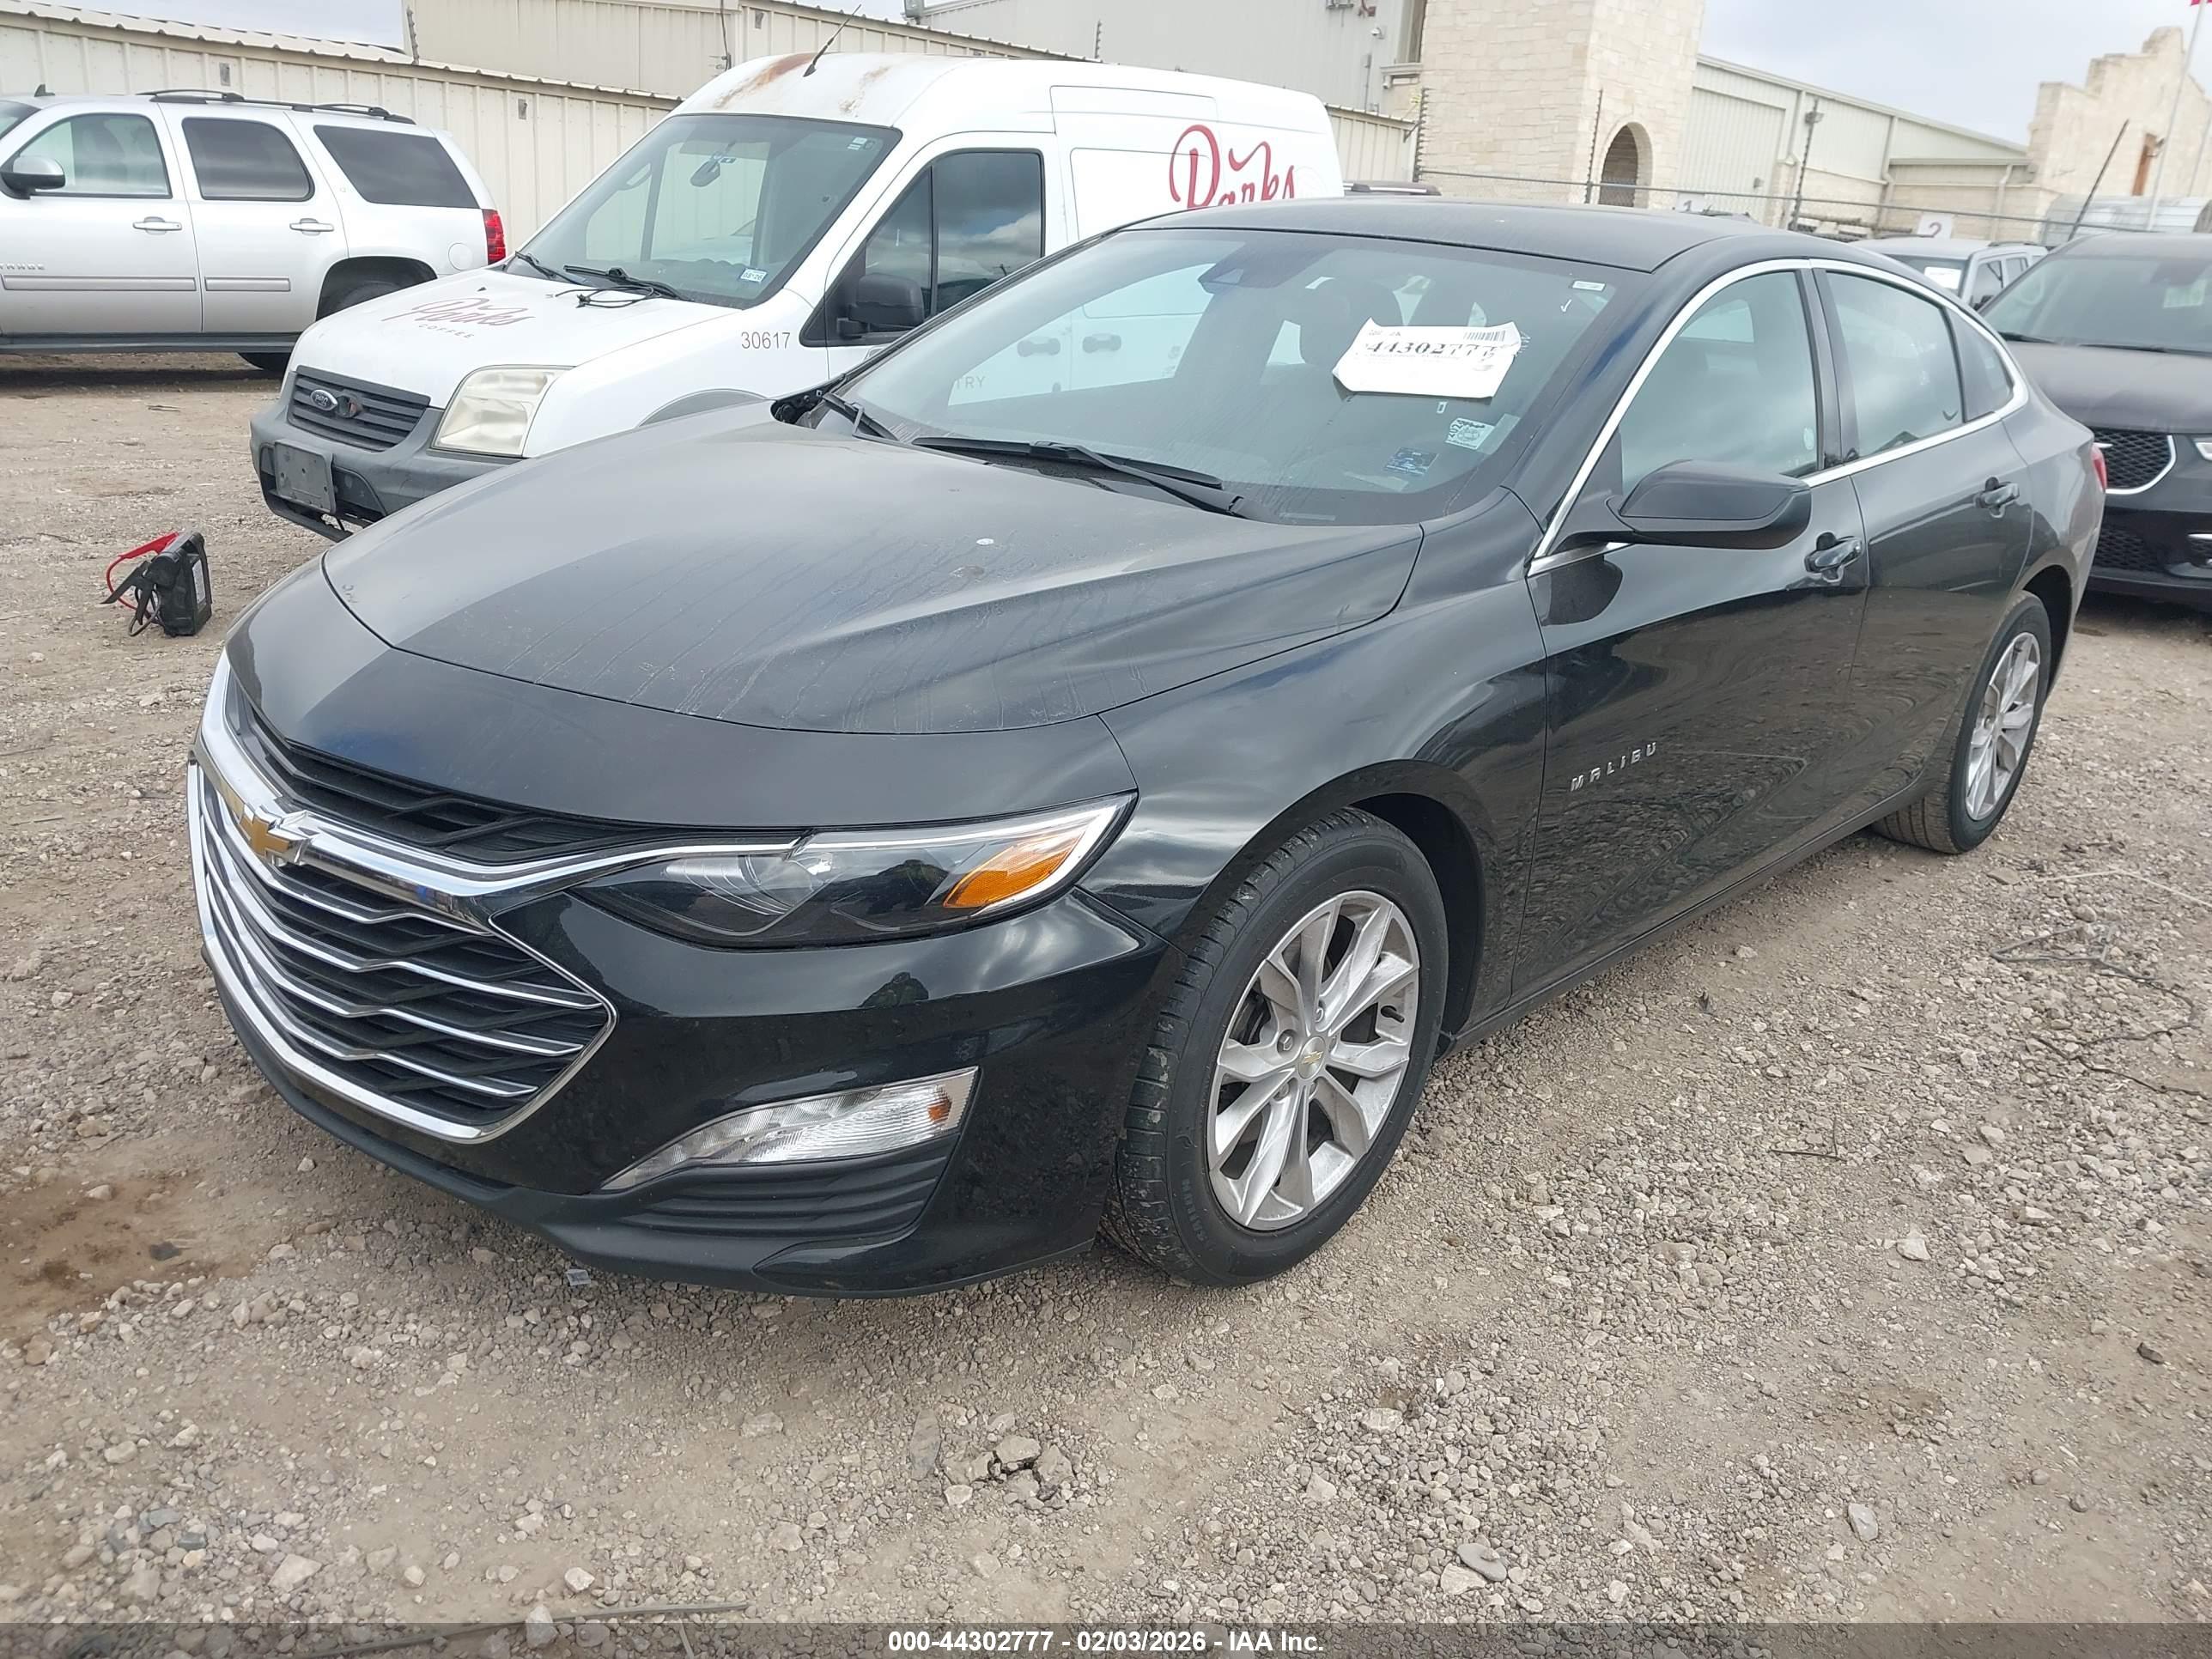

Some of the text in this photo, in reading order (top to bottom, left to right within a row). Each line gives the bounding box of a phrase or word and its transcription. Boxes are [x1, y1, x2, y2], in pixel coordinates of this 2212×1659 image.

[380, 297, 536, 326] Parks
[418, 323, 475, 338] COFFEE
[741, 331, 791, 349] 30617
[1571, 741, 1657, 792] MALIBU
